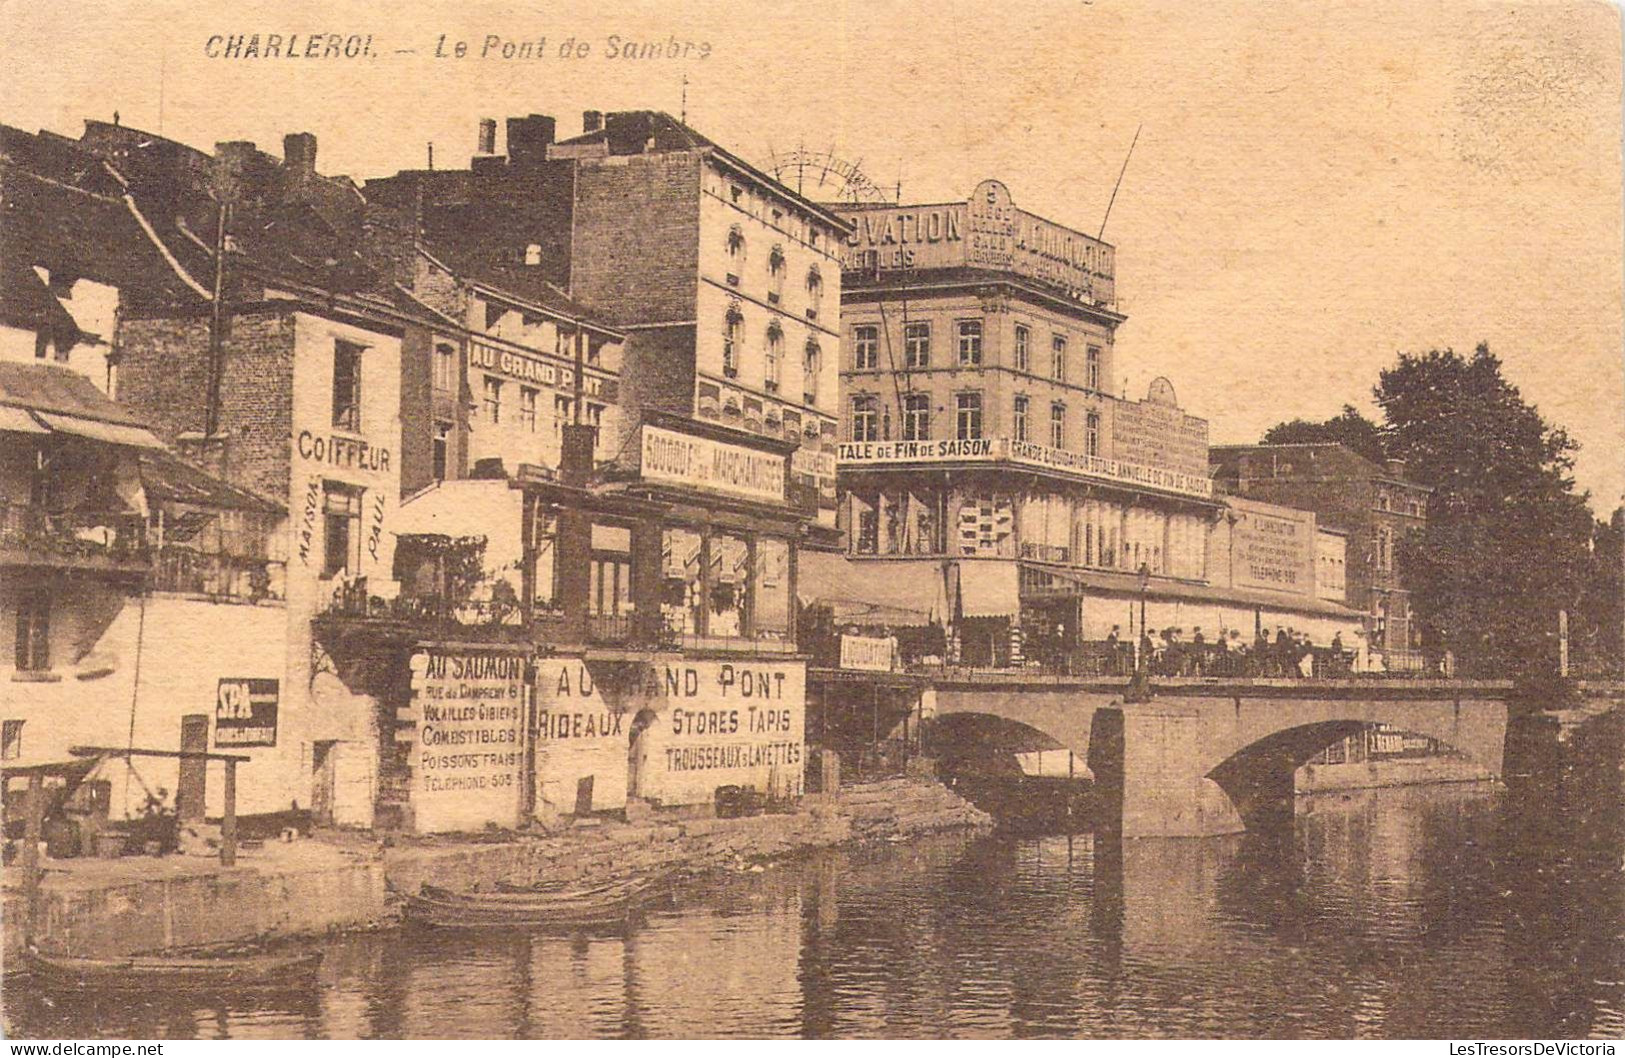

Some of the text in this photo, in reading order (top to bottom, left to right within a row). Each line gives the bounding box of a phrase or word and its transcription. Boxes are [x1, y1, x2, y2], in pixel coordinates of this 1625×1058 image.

[471, 343, 602, 397] AU GRAND PNT
[299, 430, 391, 472] COIFFEUR
[877, 446, 891, 459] DE
[894, 442, 918, 459] FIN
[920, 445, 934, 457] DE
[938, 440, 993, 457] SAISON.
[1011, 440, 1043, 462] GRANDE
[1090, 456, 1116, 477] TOTALE
[1117, 463, 1152, 483] ANNUELLE
[1153, 470, 1162, 486] DE
[1163, 471, 1175, 488] FIN
[299, 474, 322, 566] MAISON
[368, 494, 386, 564] PAUL
[426, 655, 520, 680] AU SAUMON
[718, 664, 786, 699] PONT
[217, 683, 253, 719] SPA
[426, 685, 444, 699] RUE
[422, 725, 516, 747] COMESTIBLES
[537, 705, 791, 740] RIDEAUX STORES TAPIS
[421, 751, 516, 770] POISSONS FRAIS
[665, 746, 741, 772] TROUSSEAUX
[748, 742, 800, 768] LAYETTES
[424, 774, 486, 792] TELEPHONE
